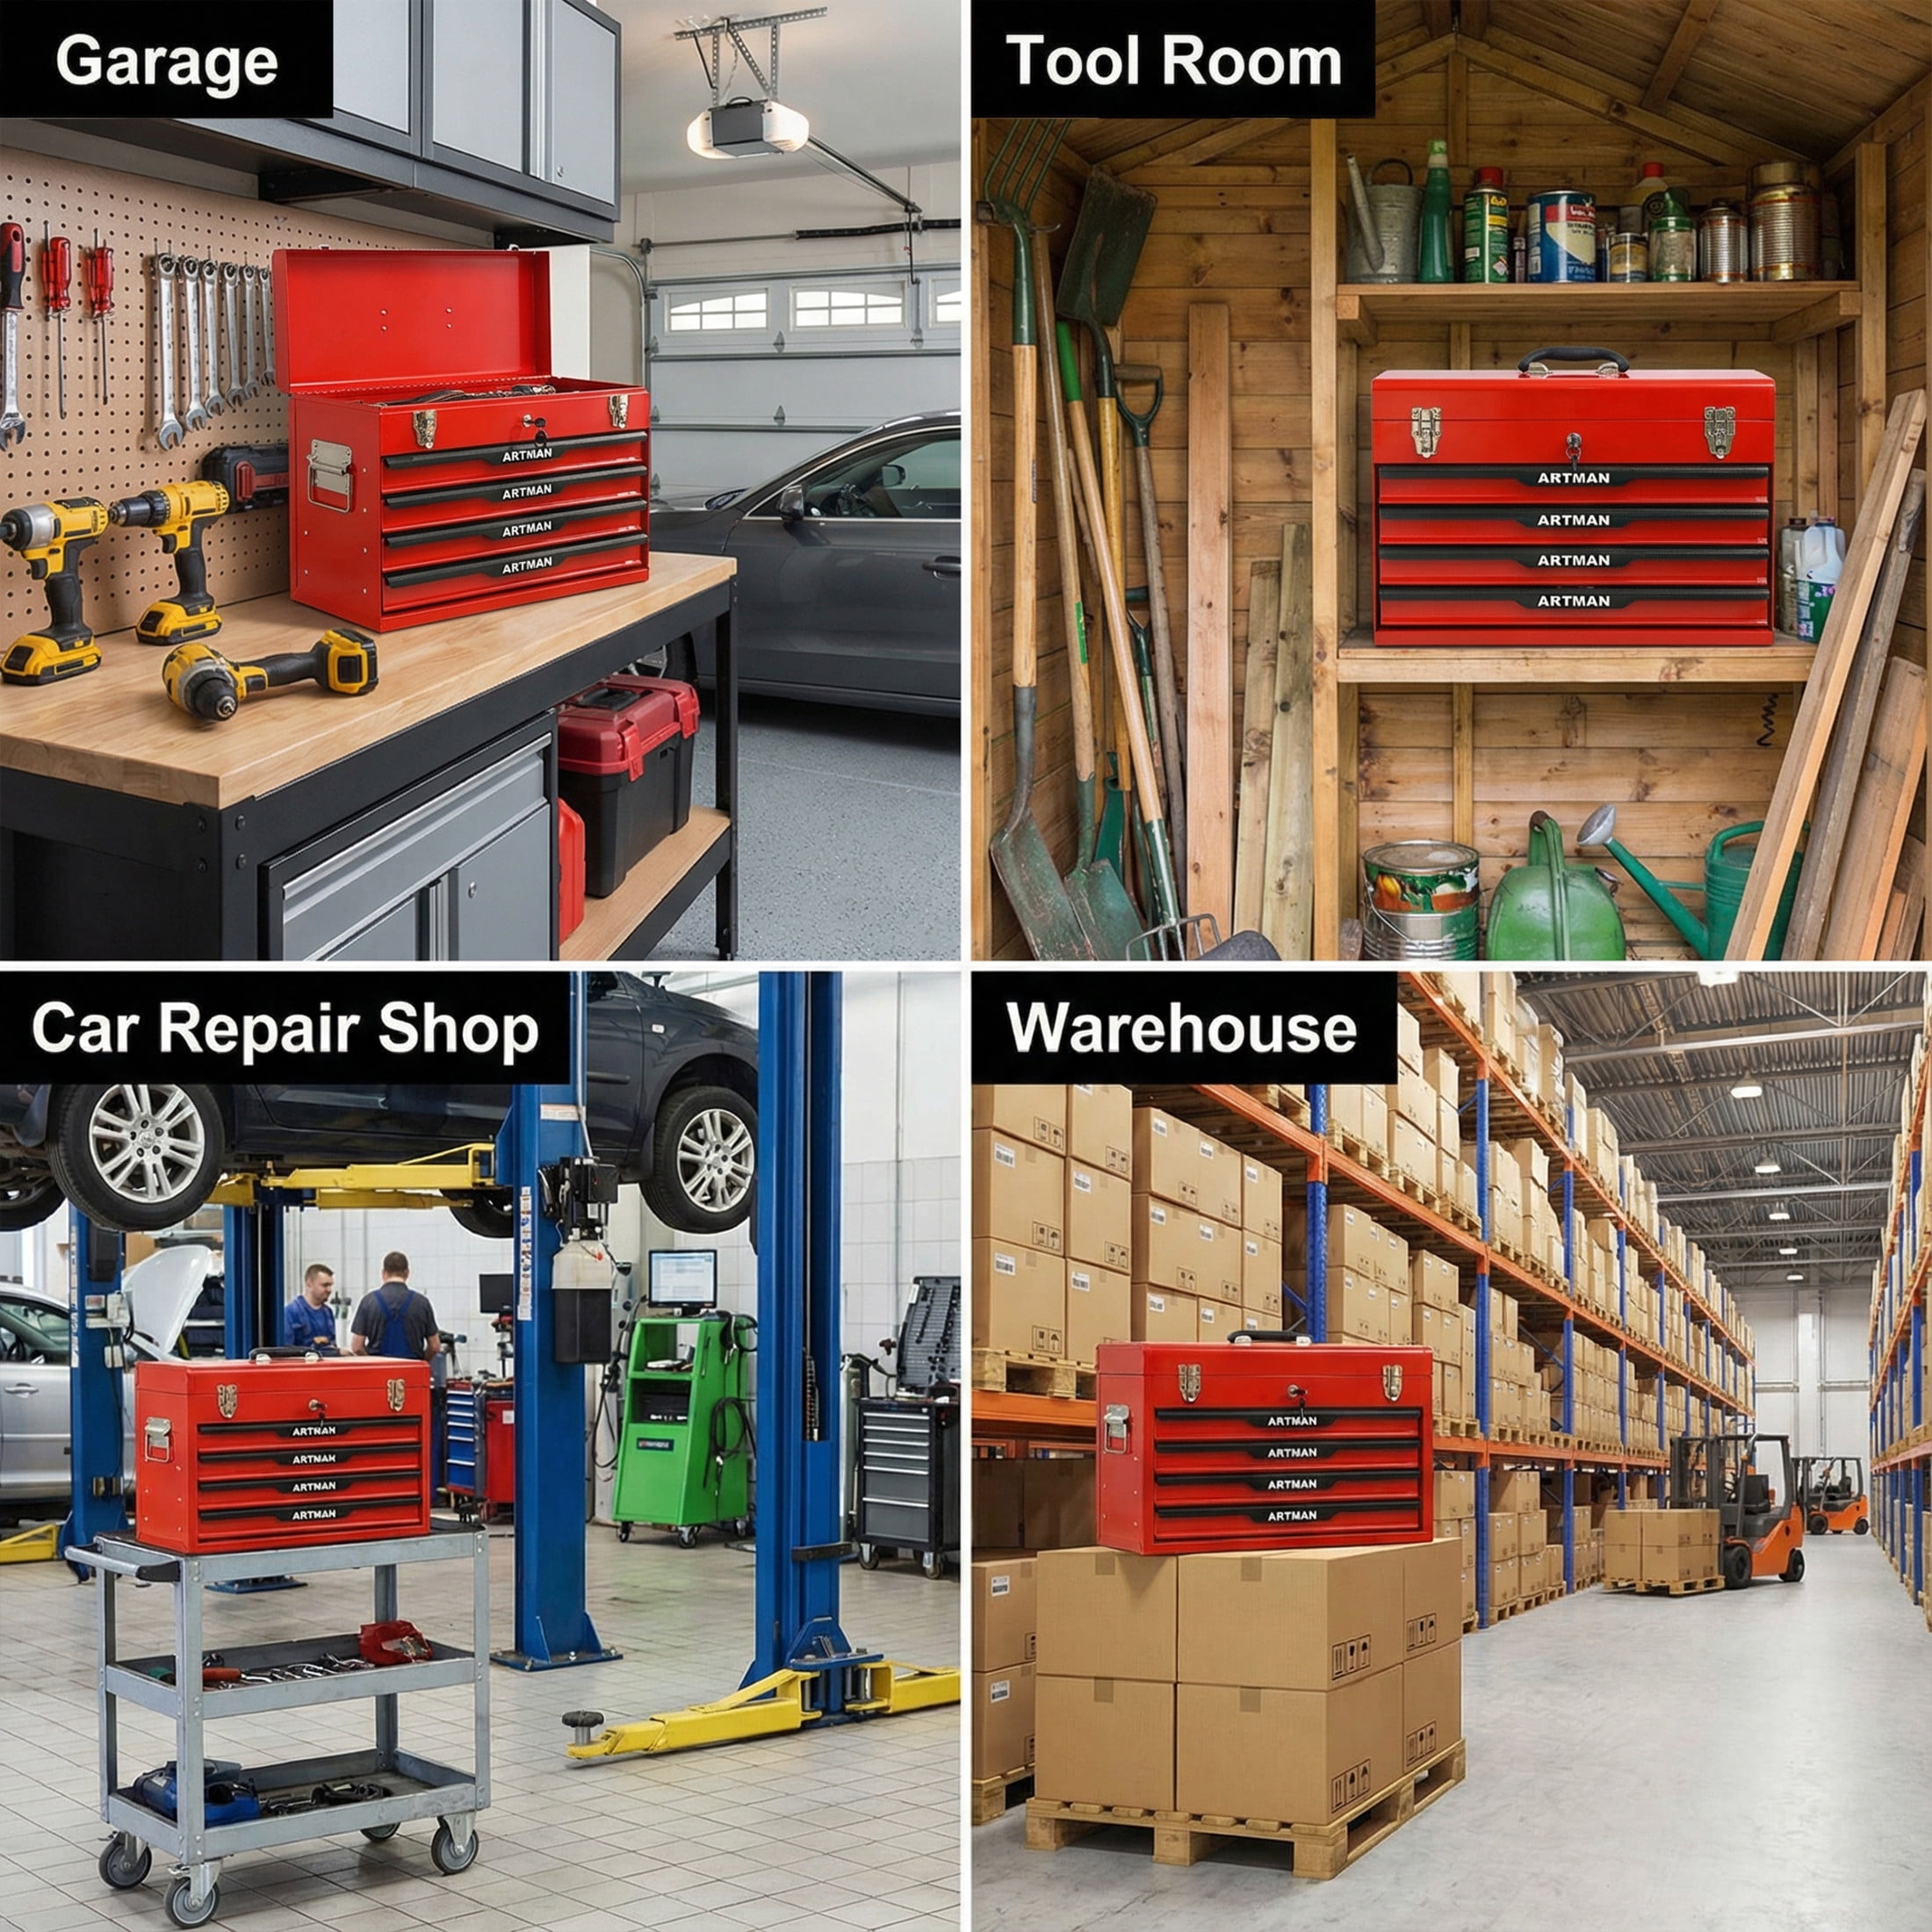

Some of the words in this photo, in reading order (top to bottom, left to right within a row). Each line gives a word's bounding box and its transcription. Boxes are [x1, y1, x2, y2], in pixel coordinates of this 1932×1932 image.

[502, 447, 552, 463] ARTMAN
[1537, 472, 1611, 484] ARTMAN
[502, 483, 552, 500] ARTMAN
[1537, 514, 1611, 526] ARTMAN
[502, 520, 551, 537] ARTMAN
[501, 556, 552, 574] ARTMAN
[1537, 554, 1611, 566] ARTMAN
[1537, 595, 1611, 607] ARTMAN
[1267, 1416, 1317, 1426] ARTMAN
[1267, 1447, 1317, 1458] ARTMAN
[1267, 1479, 1317, 1490] ARTMAN
[1267, 1510, 1317, 1522] ARTMAN
